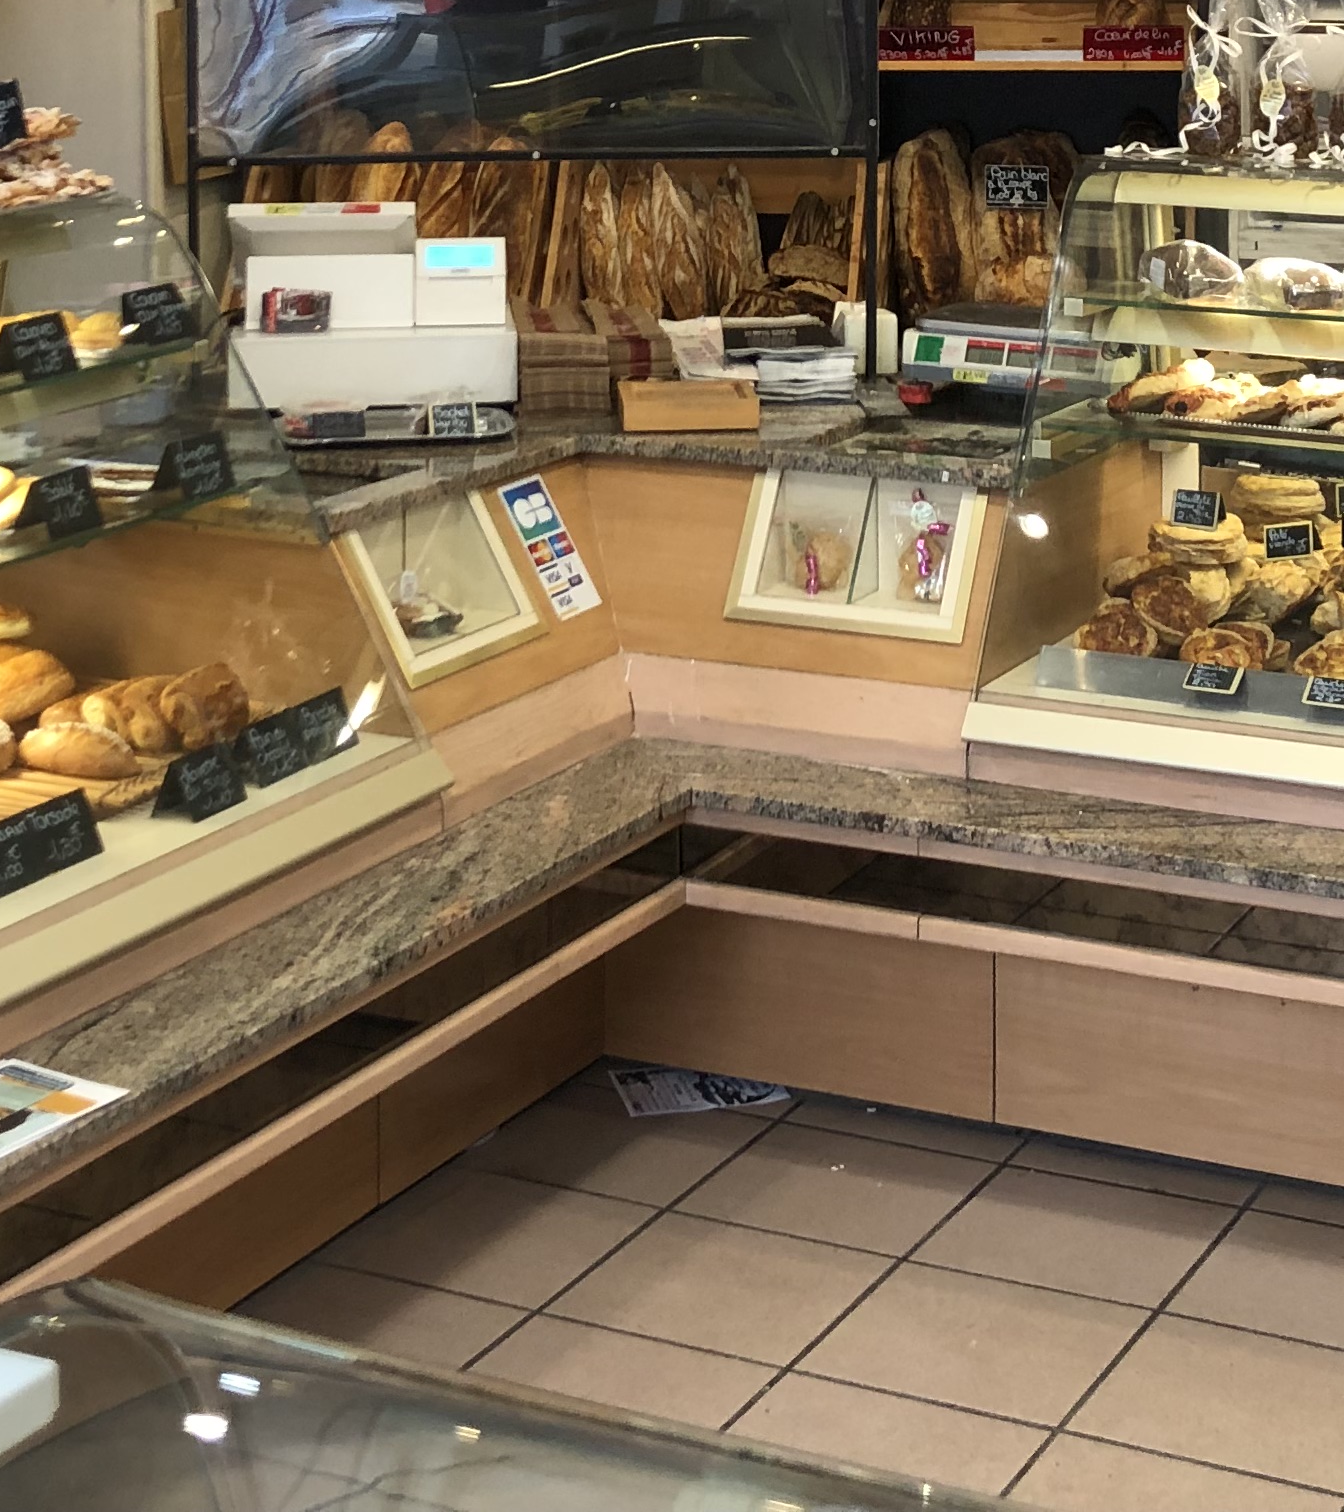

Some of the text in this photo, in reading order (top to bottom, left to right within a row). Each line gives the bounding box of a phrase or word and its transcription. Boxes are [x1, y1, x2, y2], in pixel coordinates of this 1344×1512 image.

[890, 30, 961, 46] VIKING
[990, 166, 1049, 181] Pain blanc
